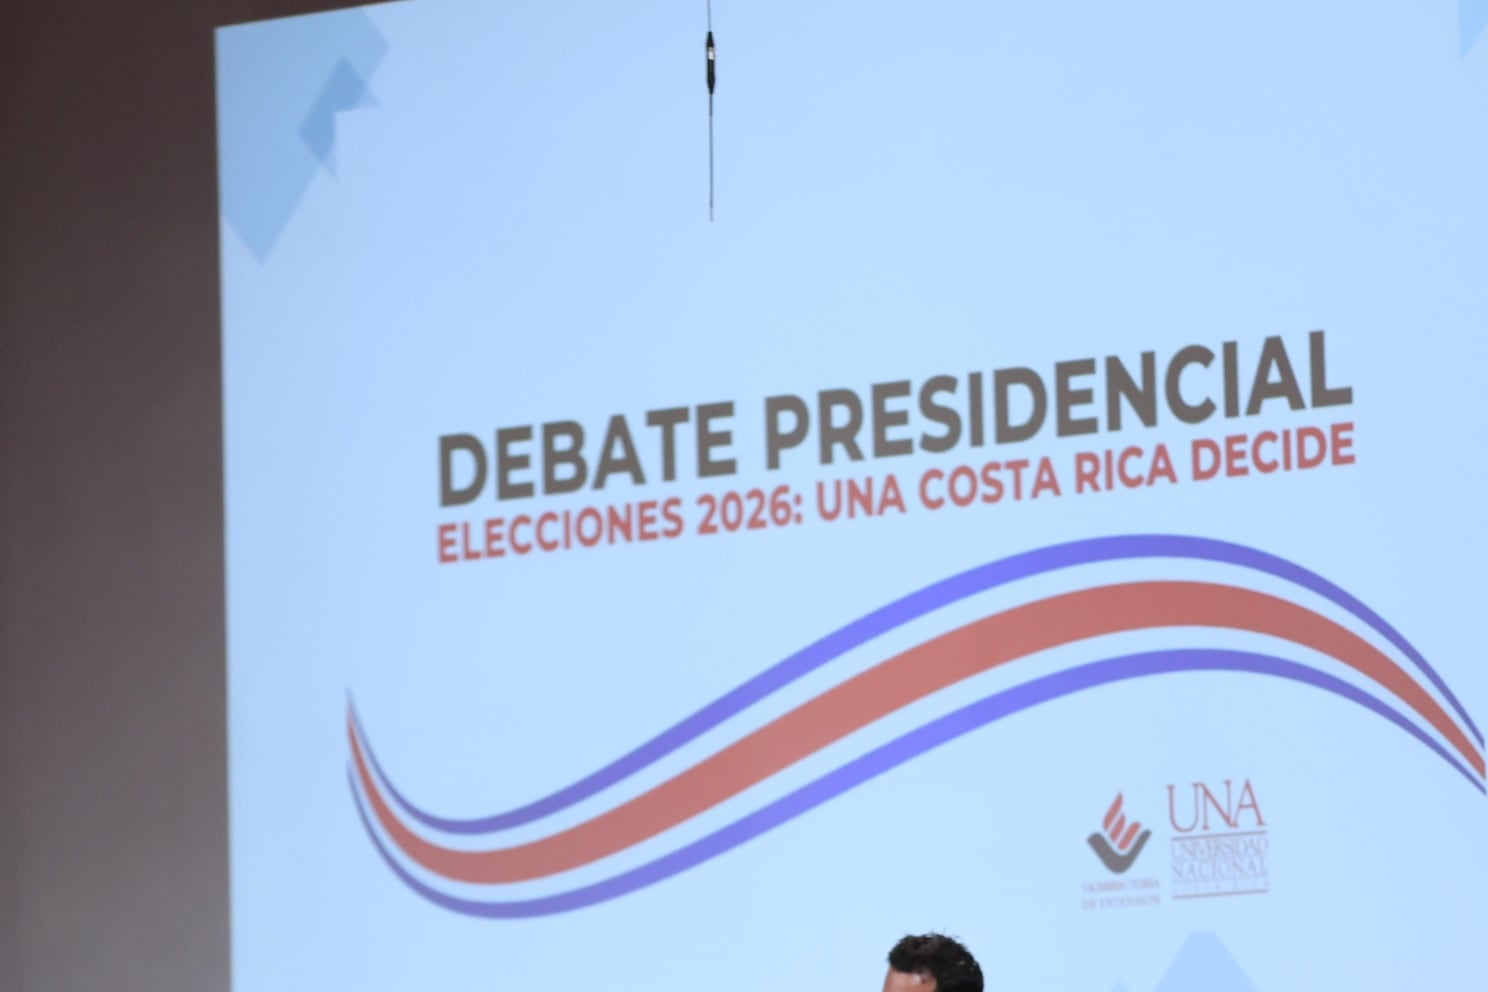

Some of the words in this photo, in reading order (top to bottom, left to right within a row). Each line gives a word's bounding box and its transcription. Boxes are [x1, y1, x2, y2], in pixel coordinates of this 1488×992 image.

[439, 401, 737, 507] DEBATE
[765, 331, 1353, 470] PRESIDENCIAL
[438, 497, 684, 563] ELECCIONES
[697, 485, 803, 535] 2026:
[817, 475, 907, 521] UNA
[919, 457, 1061, 510] COSTA
[1075, 444, 1177, 494] RICA
[1192, 422, 1355, 481] DECIDE
[1166, 778, 1266, 833] UNA
